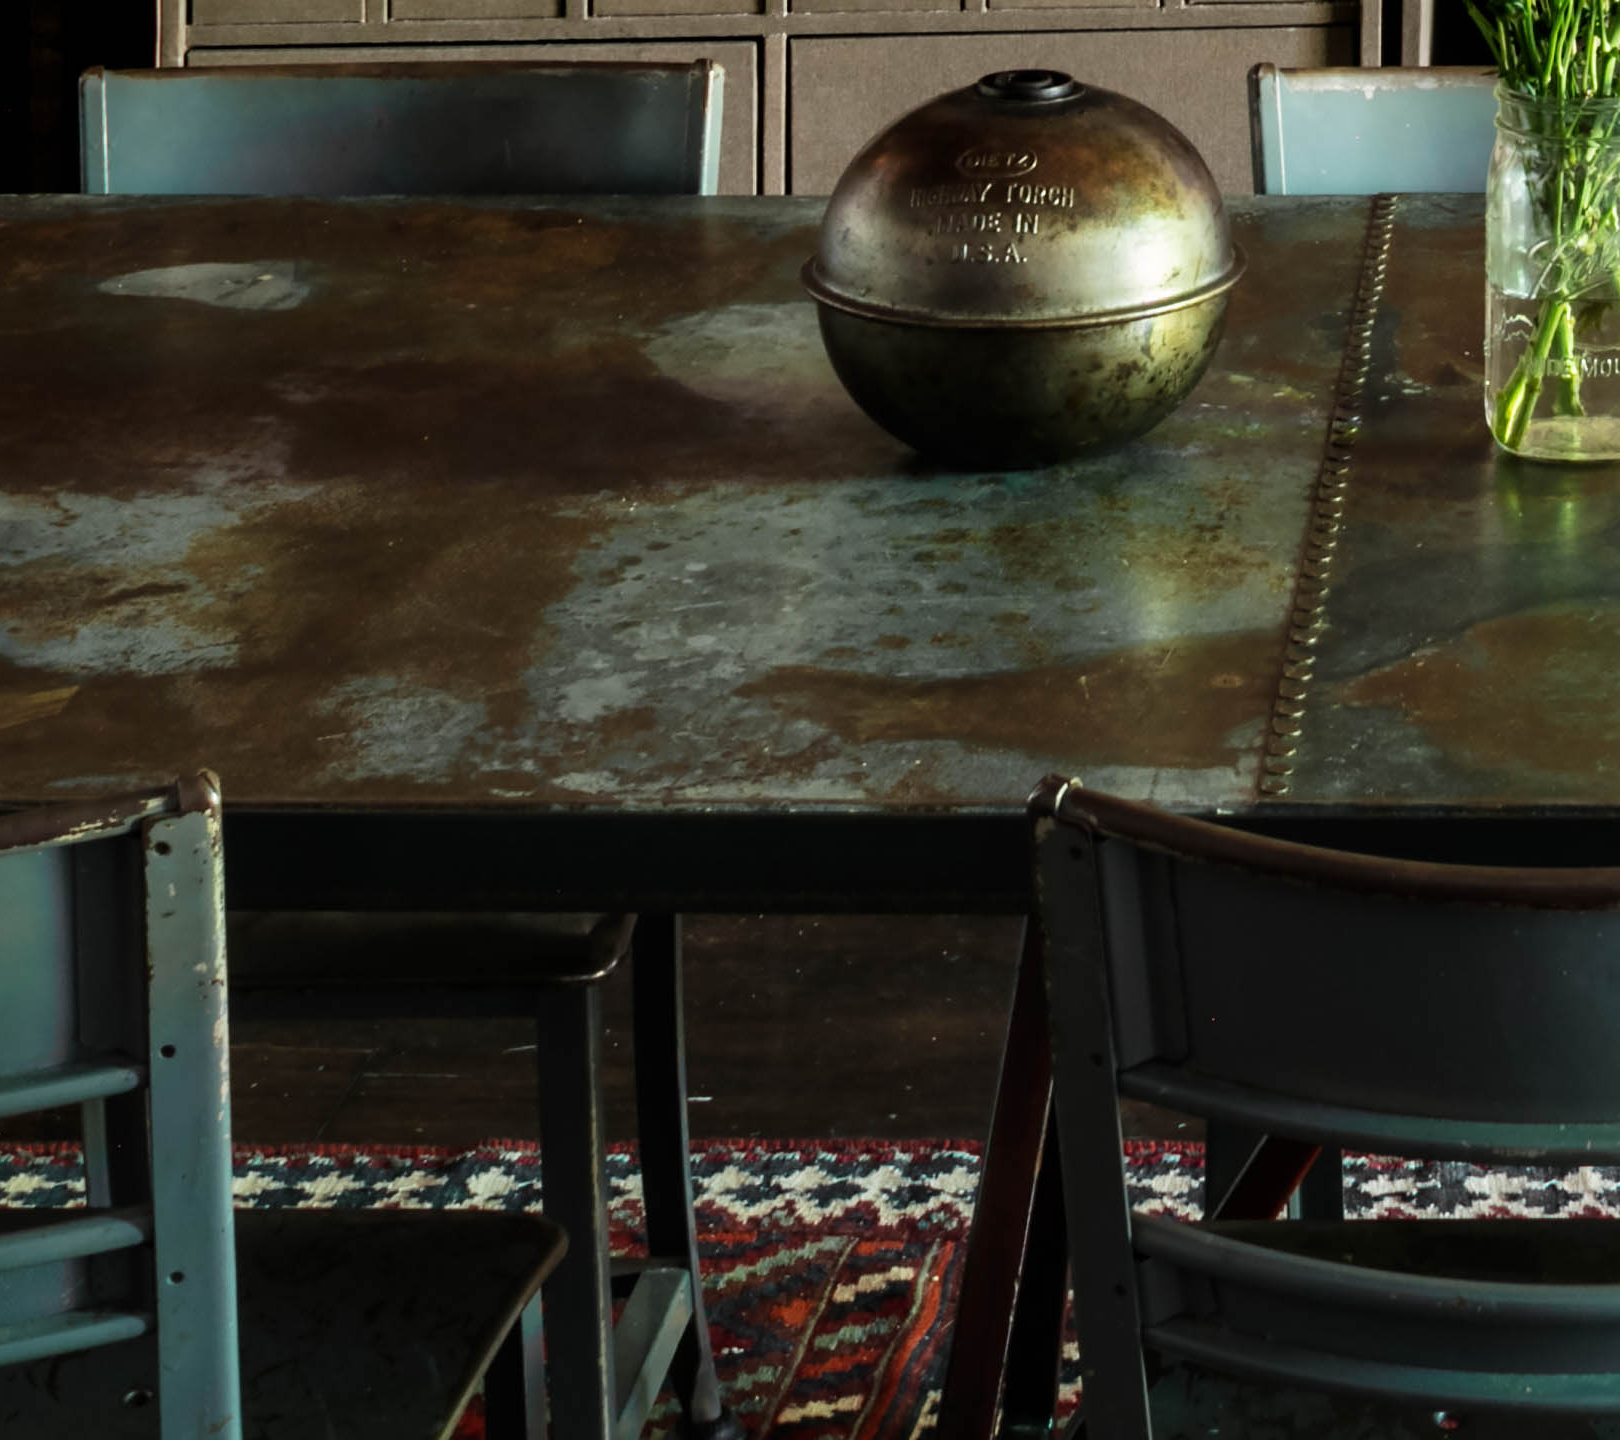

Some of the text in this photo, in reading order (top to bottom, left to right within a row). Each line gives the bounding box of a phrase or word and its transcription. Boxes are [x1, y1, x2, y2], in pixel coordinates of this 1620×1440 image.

[1007, 183, 1074, 208] TORCH
[1016, 213, 1039, 234] IN
[953, 243, 1028, 263] U.S.A.
